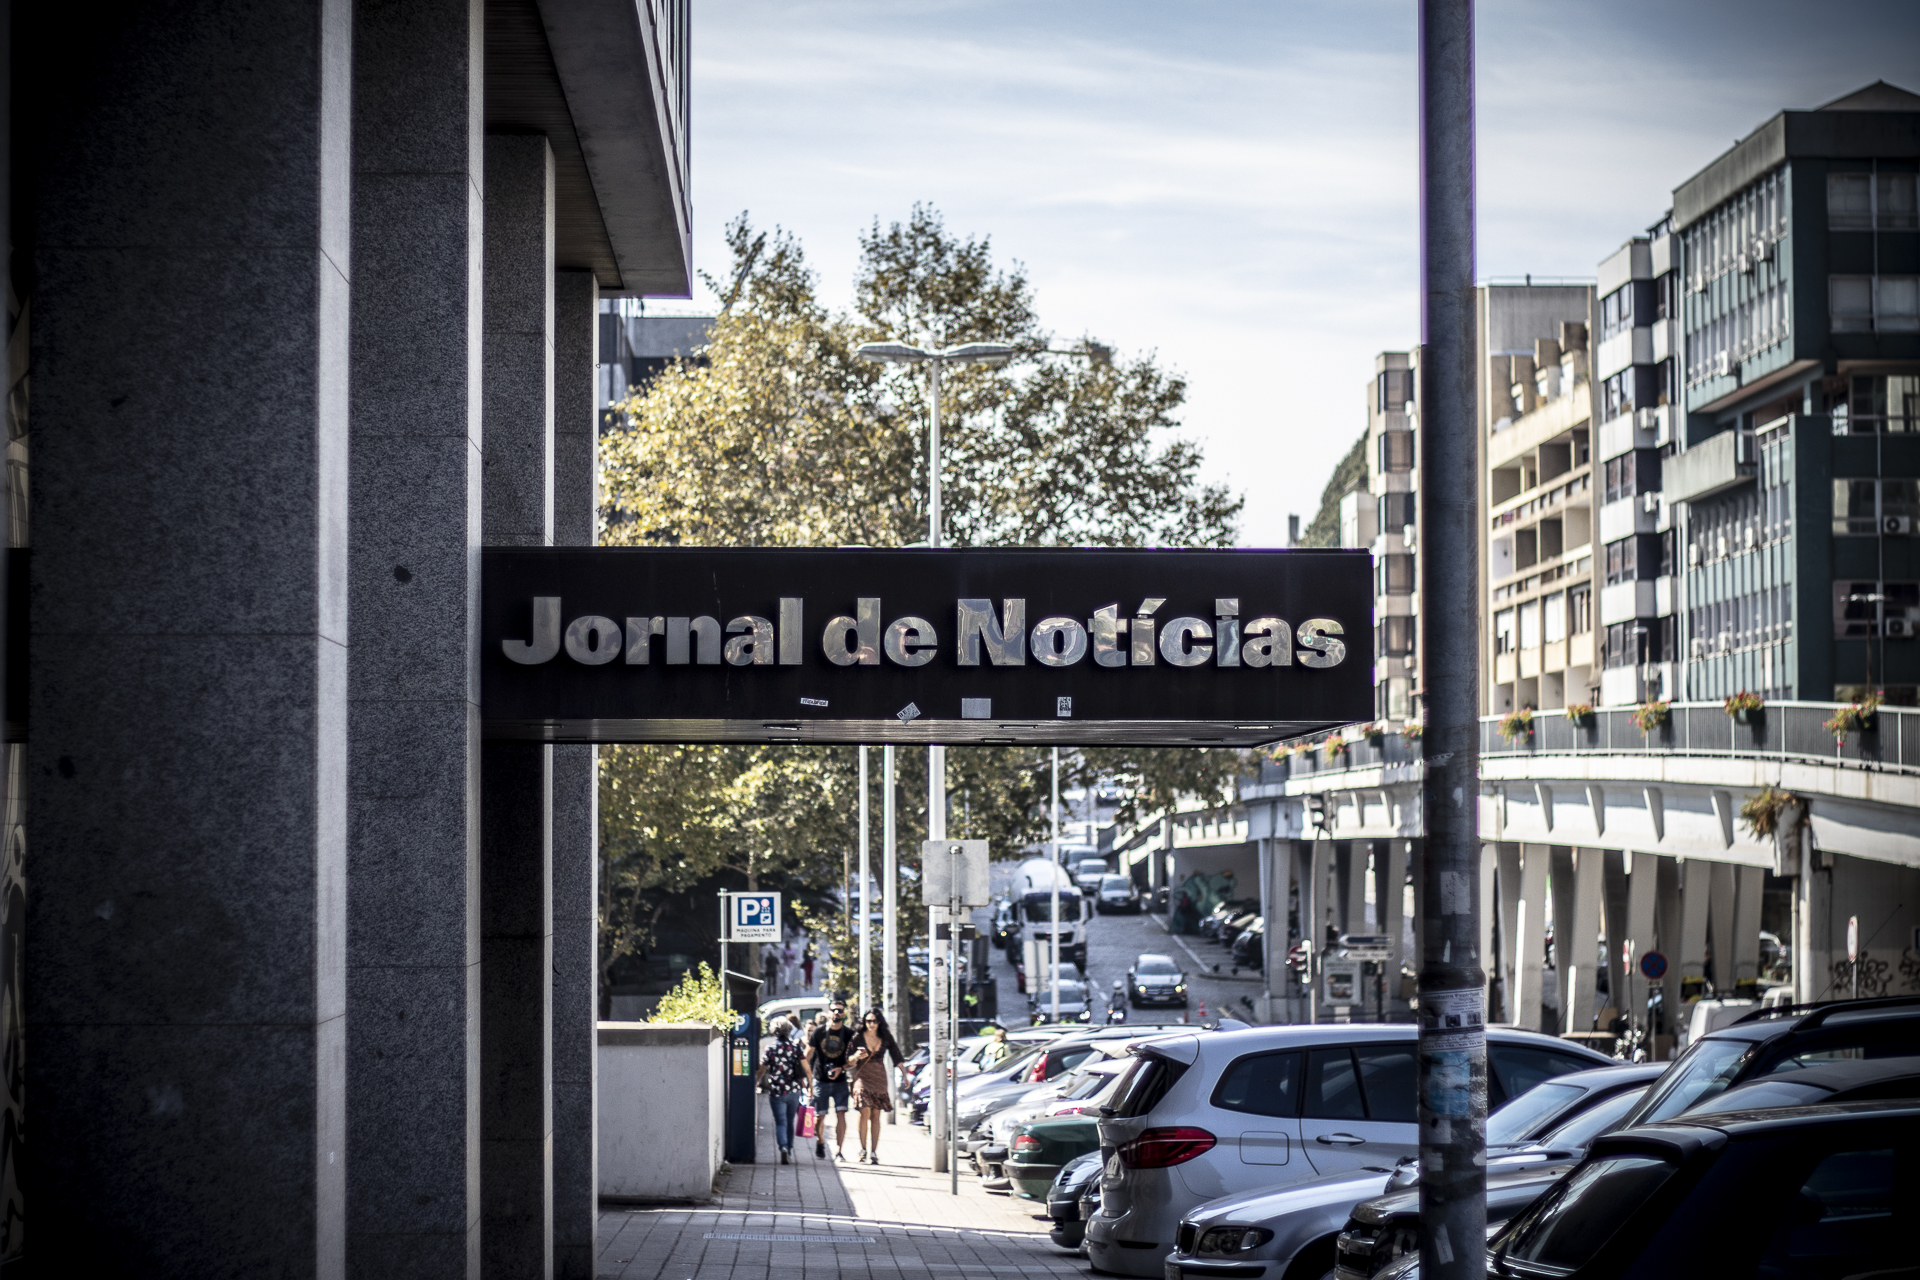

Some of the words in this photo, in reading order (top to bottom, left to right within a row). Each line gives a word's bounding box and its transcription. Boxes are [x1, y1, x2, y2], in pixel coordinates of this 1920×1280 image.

[502, 596, 803, 666] Jornal
[822, 597, 938, 667] de
[957, 598, 1346, 668] Notícias
[741, 899, 760, 924] P
